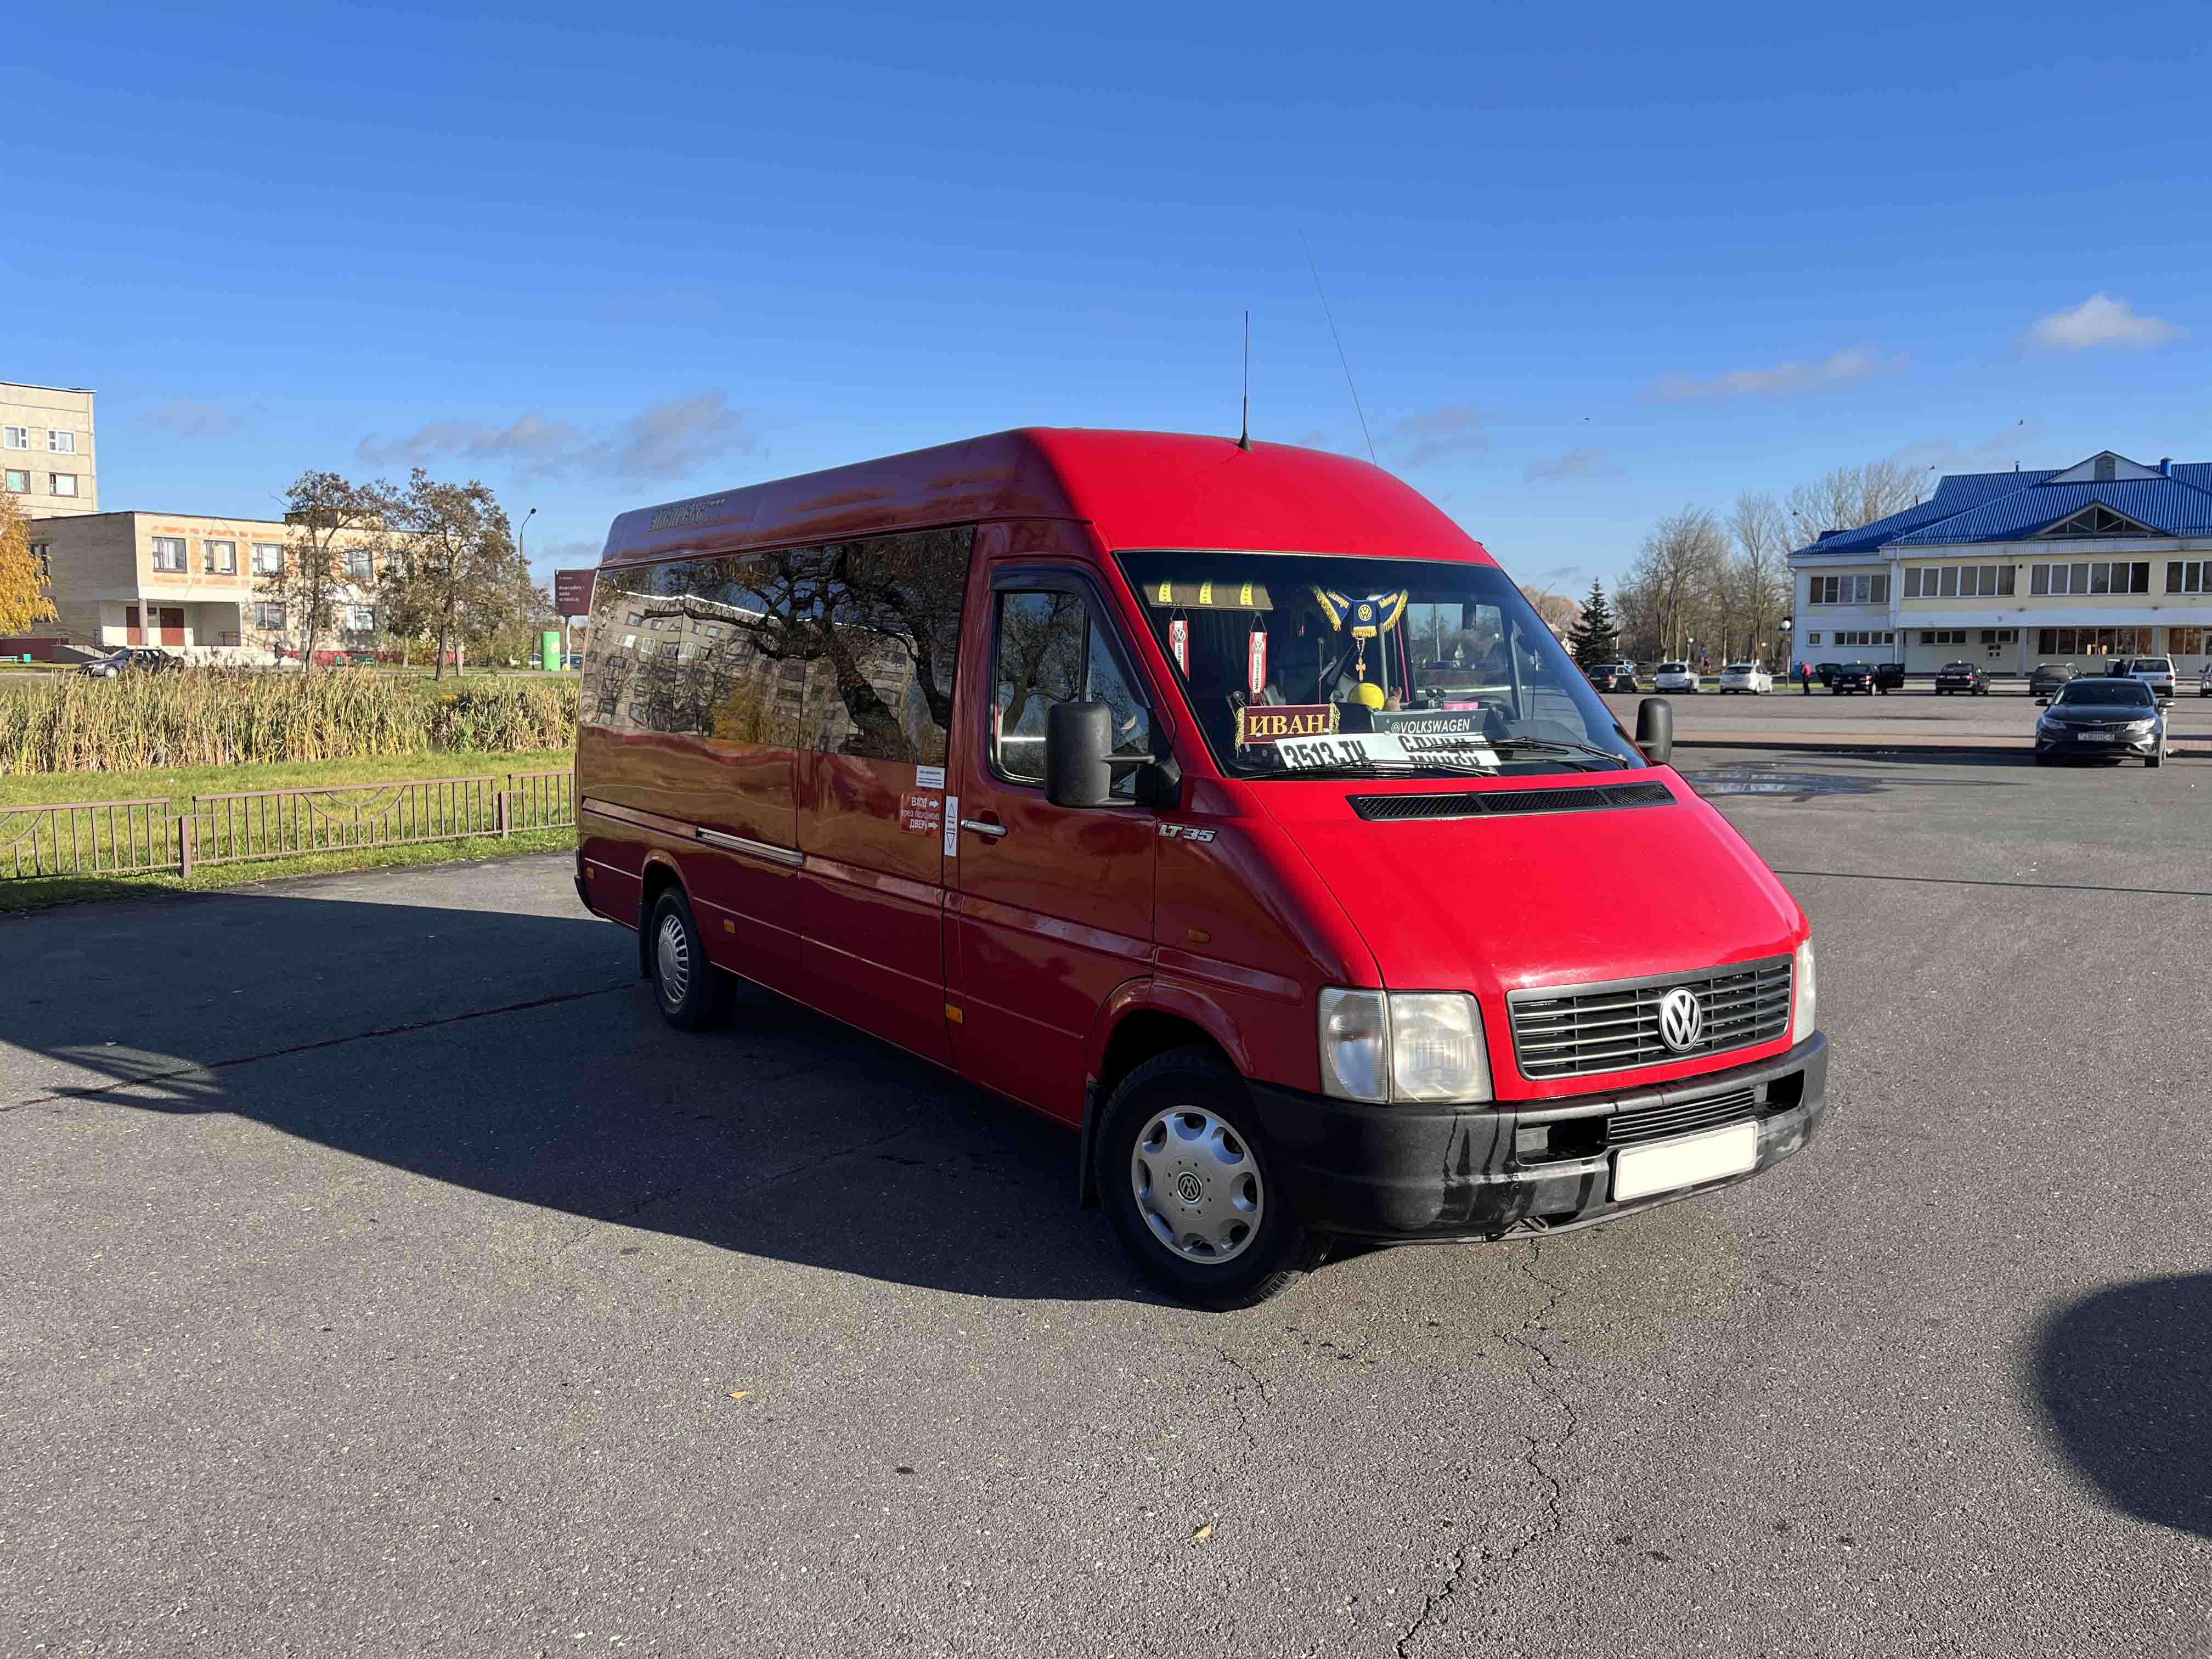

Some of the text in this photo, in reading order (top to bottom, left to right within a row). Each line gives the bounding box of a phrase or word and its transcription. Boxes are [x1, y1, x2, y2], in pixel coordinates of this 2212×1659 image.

[1249, 714, 1325, 736] ИВАН
[1401, 719, 1470, 733] VOLKSWAGEN
[1158, 824, 1217, 843] LT 35
